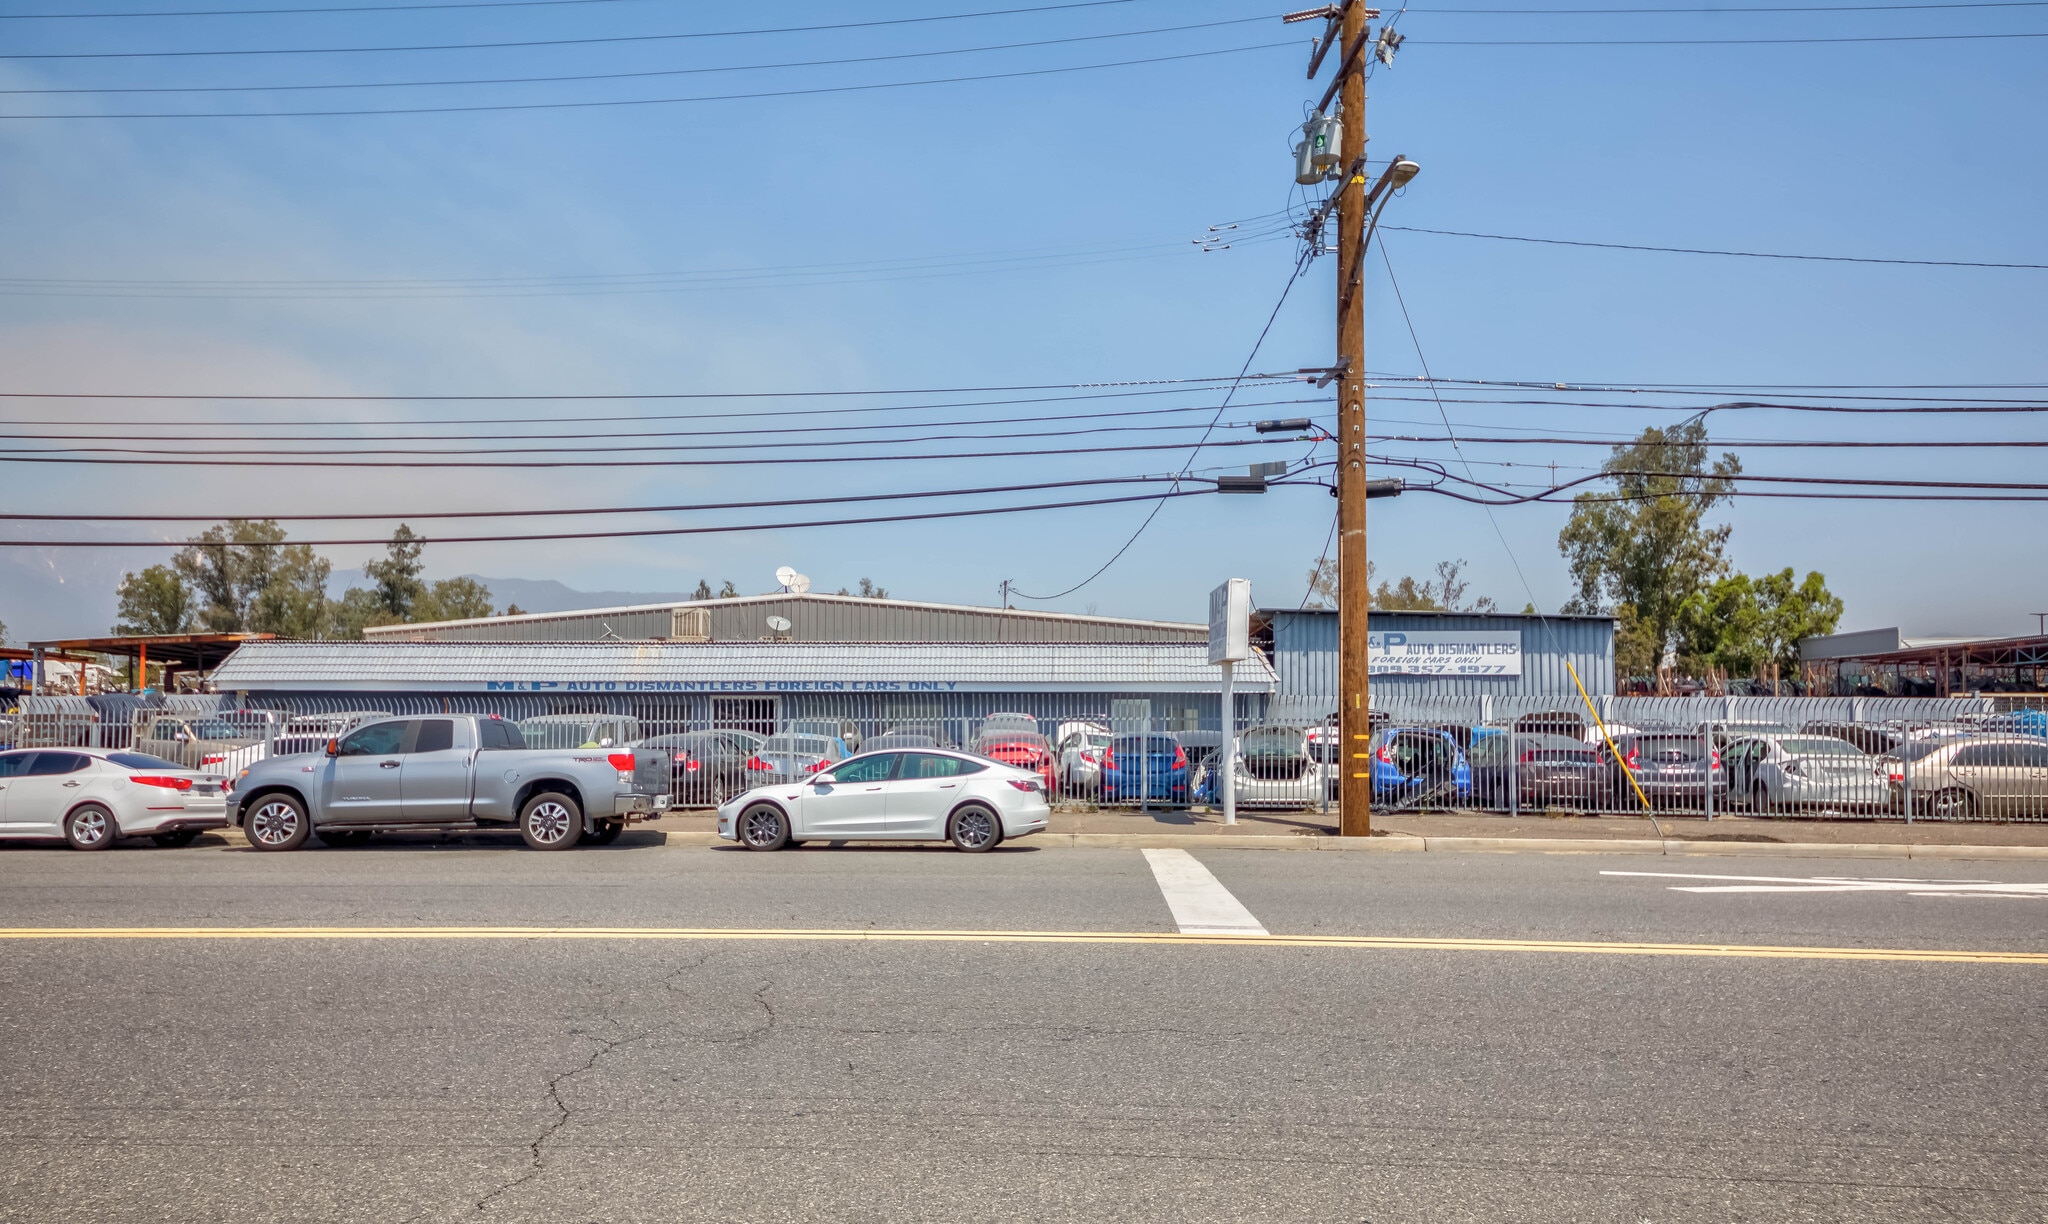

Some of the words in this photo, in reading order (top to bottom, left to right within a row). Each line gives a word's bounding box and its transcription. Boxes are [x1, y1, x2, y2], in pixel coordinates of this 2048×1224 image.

[1384, 633, 1406, 655] P
[1406, 643, 1434, 655] AUTO
[1439, 643, 1516, 655] DISMANTLERS
[1372, 656, 1421, 664] FOREIGN
[1423, 656, 1451, 664] CARS
[1454, 656, 1482, 664] ONLY
[487, 681, 515, 691] M
[517, 681, 527, 691] &
[531, 681, 558, 691] P
[567, 681, 617, 691] AUTO
[625, 681, 757, 691] DISMANTLERS
[765, 681, 844, 691] FOREIGN
[852, 681, 901, 691] CARS
[908, 681, 958, 691] ONLY
